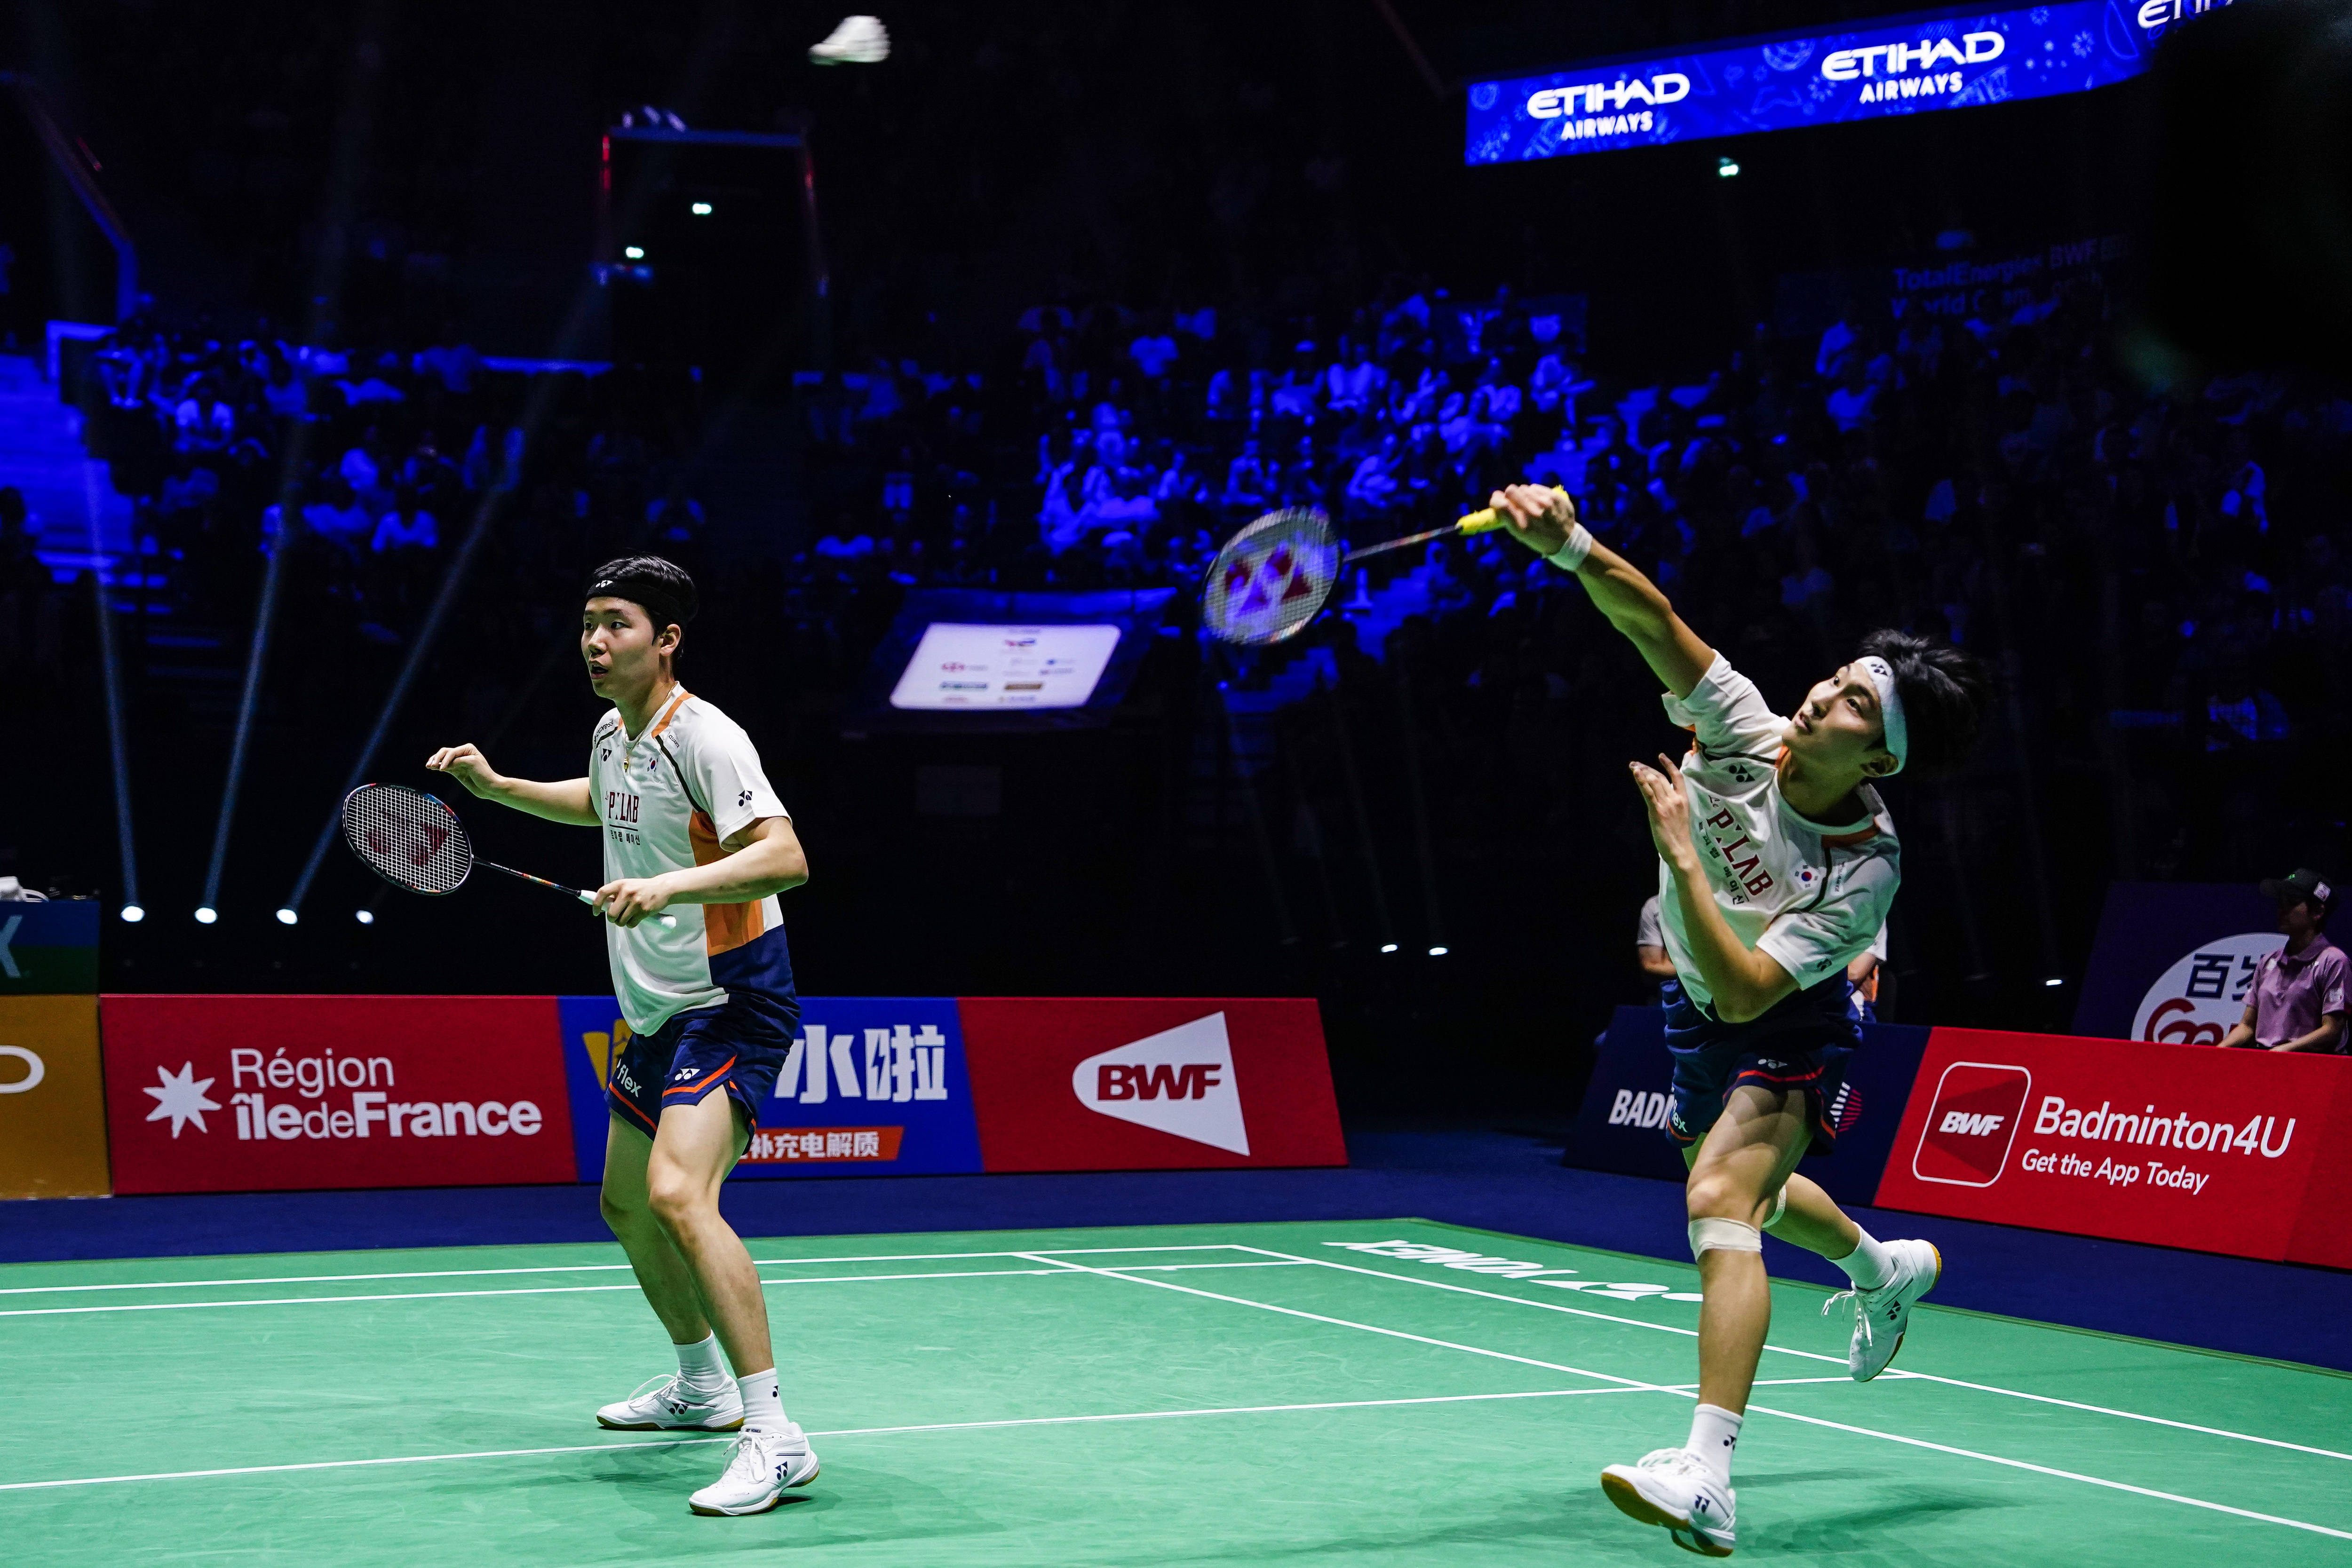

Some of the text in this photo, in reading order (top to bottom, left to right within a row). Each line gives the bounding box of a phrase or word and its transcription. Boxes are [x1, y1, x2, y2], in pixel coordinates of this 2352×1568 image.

[1821, 31, 2005, 81] ETIHAD
[1527, 73, 1691, 119] ETIHAD
[1859, 71, 1963, 104] AIRWAYS
[1561, 111, 1653, 141] AIRWAYS
[231, 1047, 395, 1098] Région
[1097, 1064, 1222, 1101] BWF
[1939, 1111, 2004, 1136] BWF
[2034, 1096, 2296, 1158] Badminton4U
[740, 1131, 879, 1160] 补充电解质
[2022, 1148, 2209, 1195] Get the App Today
